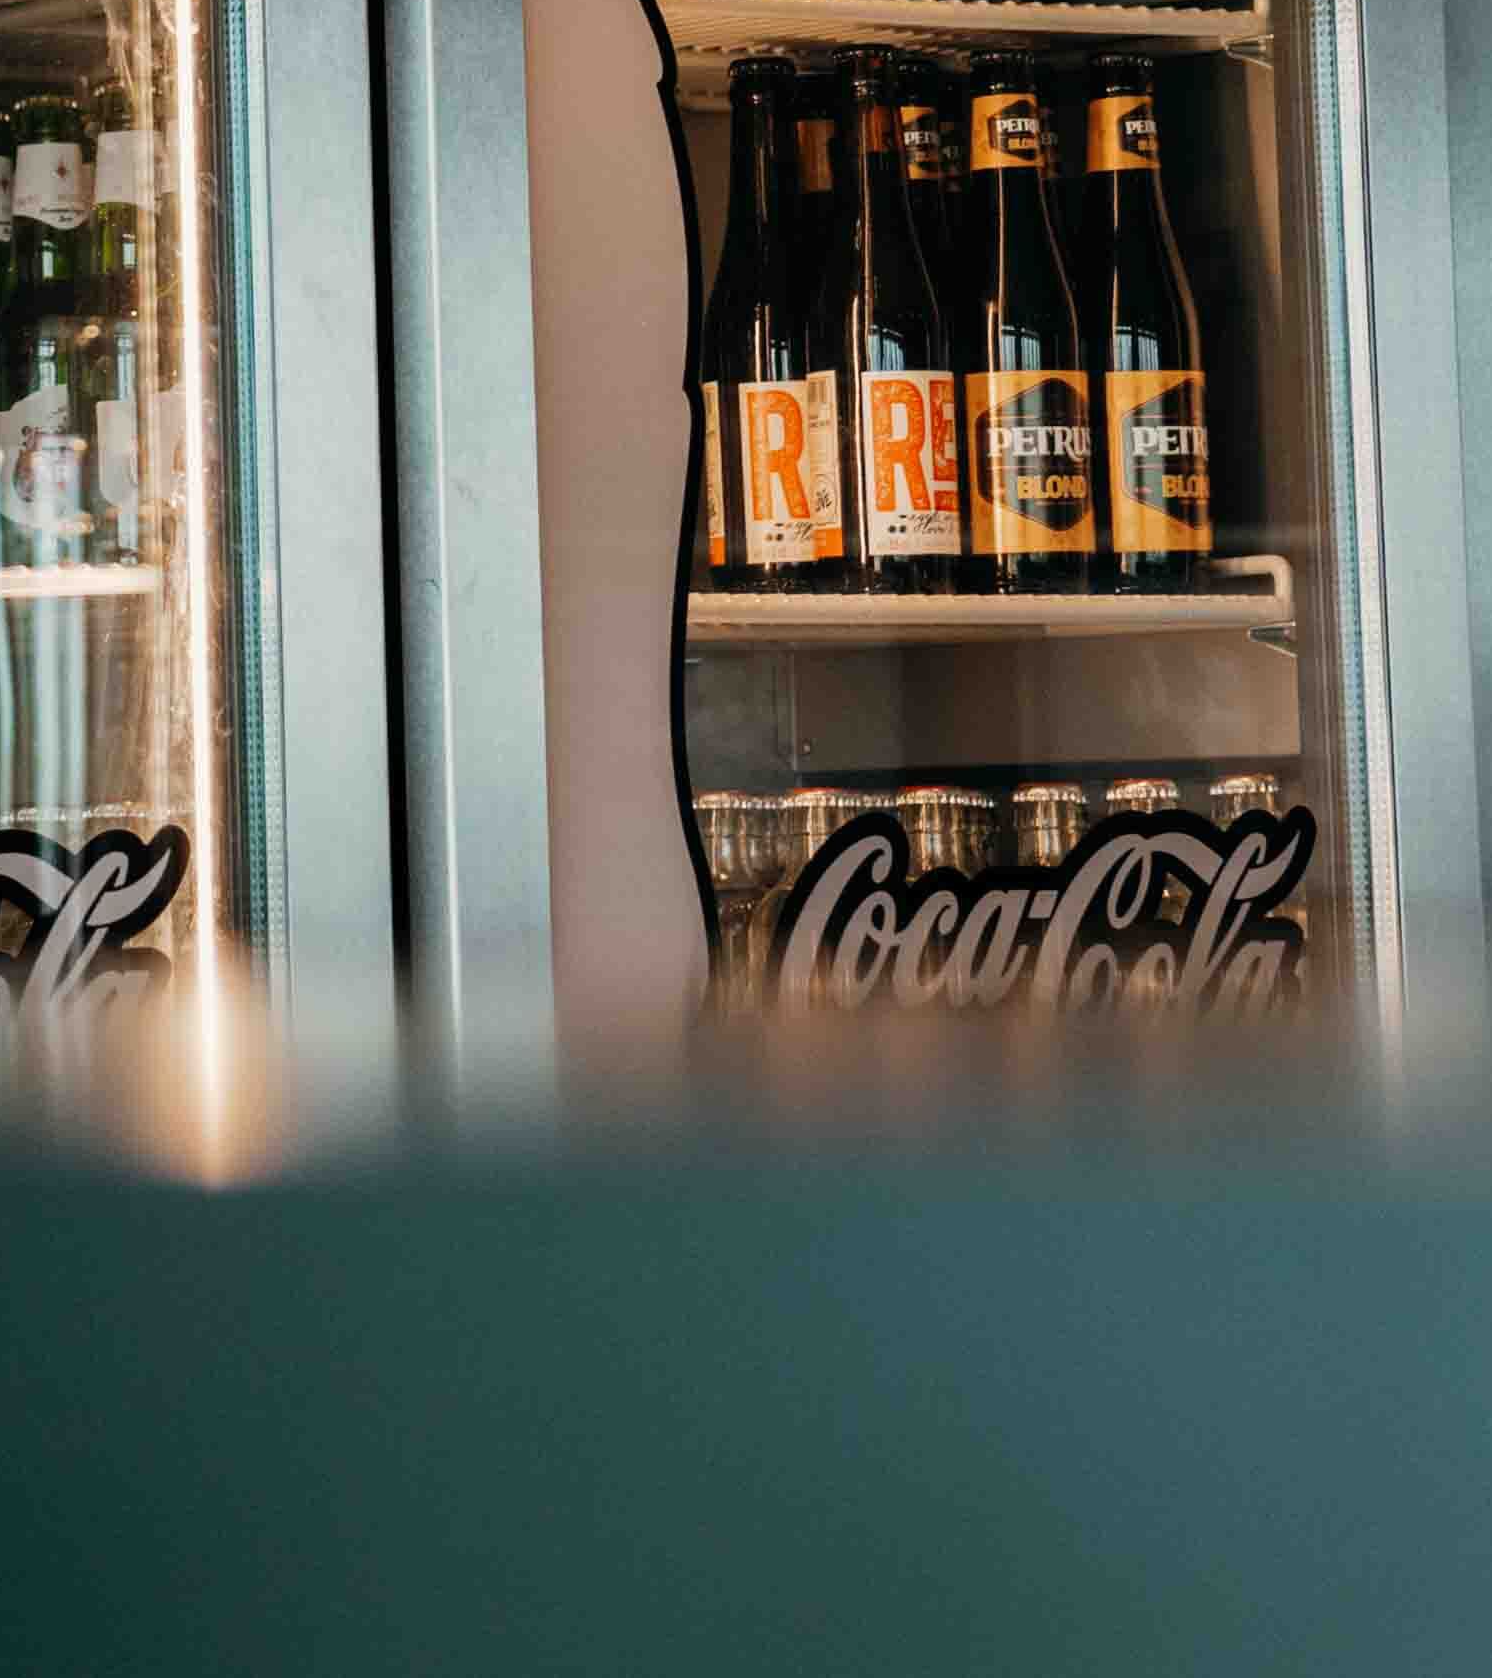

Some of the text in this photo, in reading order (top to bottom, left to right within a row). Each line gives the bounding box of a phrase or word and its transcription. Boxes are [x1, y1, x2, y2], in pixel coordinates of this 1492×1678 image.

[987, 425, 1091, 462] PETRU
[1131, 425, 1208, 462] PETR
[780, 826, 1303, 1017] Coca-Cola
